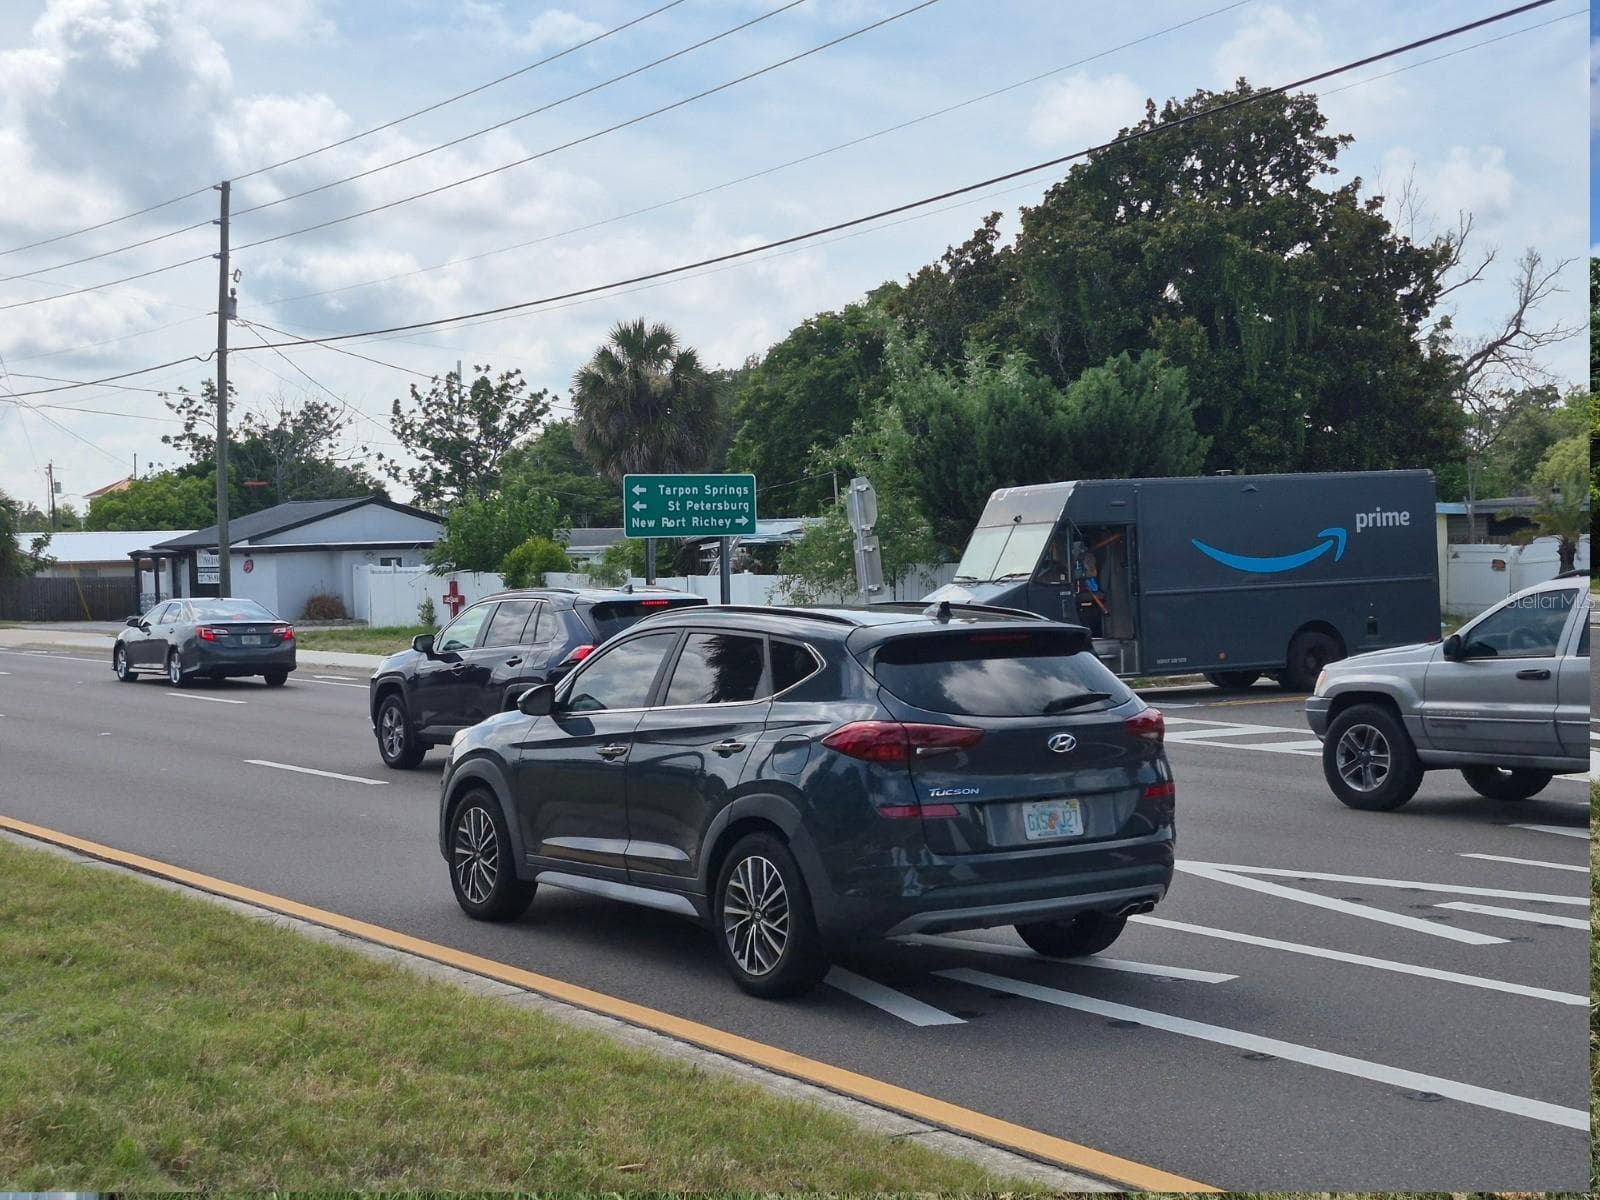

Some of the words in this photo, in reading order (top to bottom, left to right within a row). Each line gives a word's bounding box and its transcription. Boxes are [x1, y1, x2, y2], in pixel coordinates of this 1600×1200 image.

[658, 484, 699, 497] Tarpon
[704, 484, 749, 497] Springs
[667, 501, 680, 511] St
[686, 500, 749, 512] Petersburg
[631, 517, 656, 528] New
[661, 517, 686, 528] Port
[692, 516, 732, 528] Richey
[1356, 507, 1410, 533] prime
